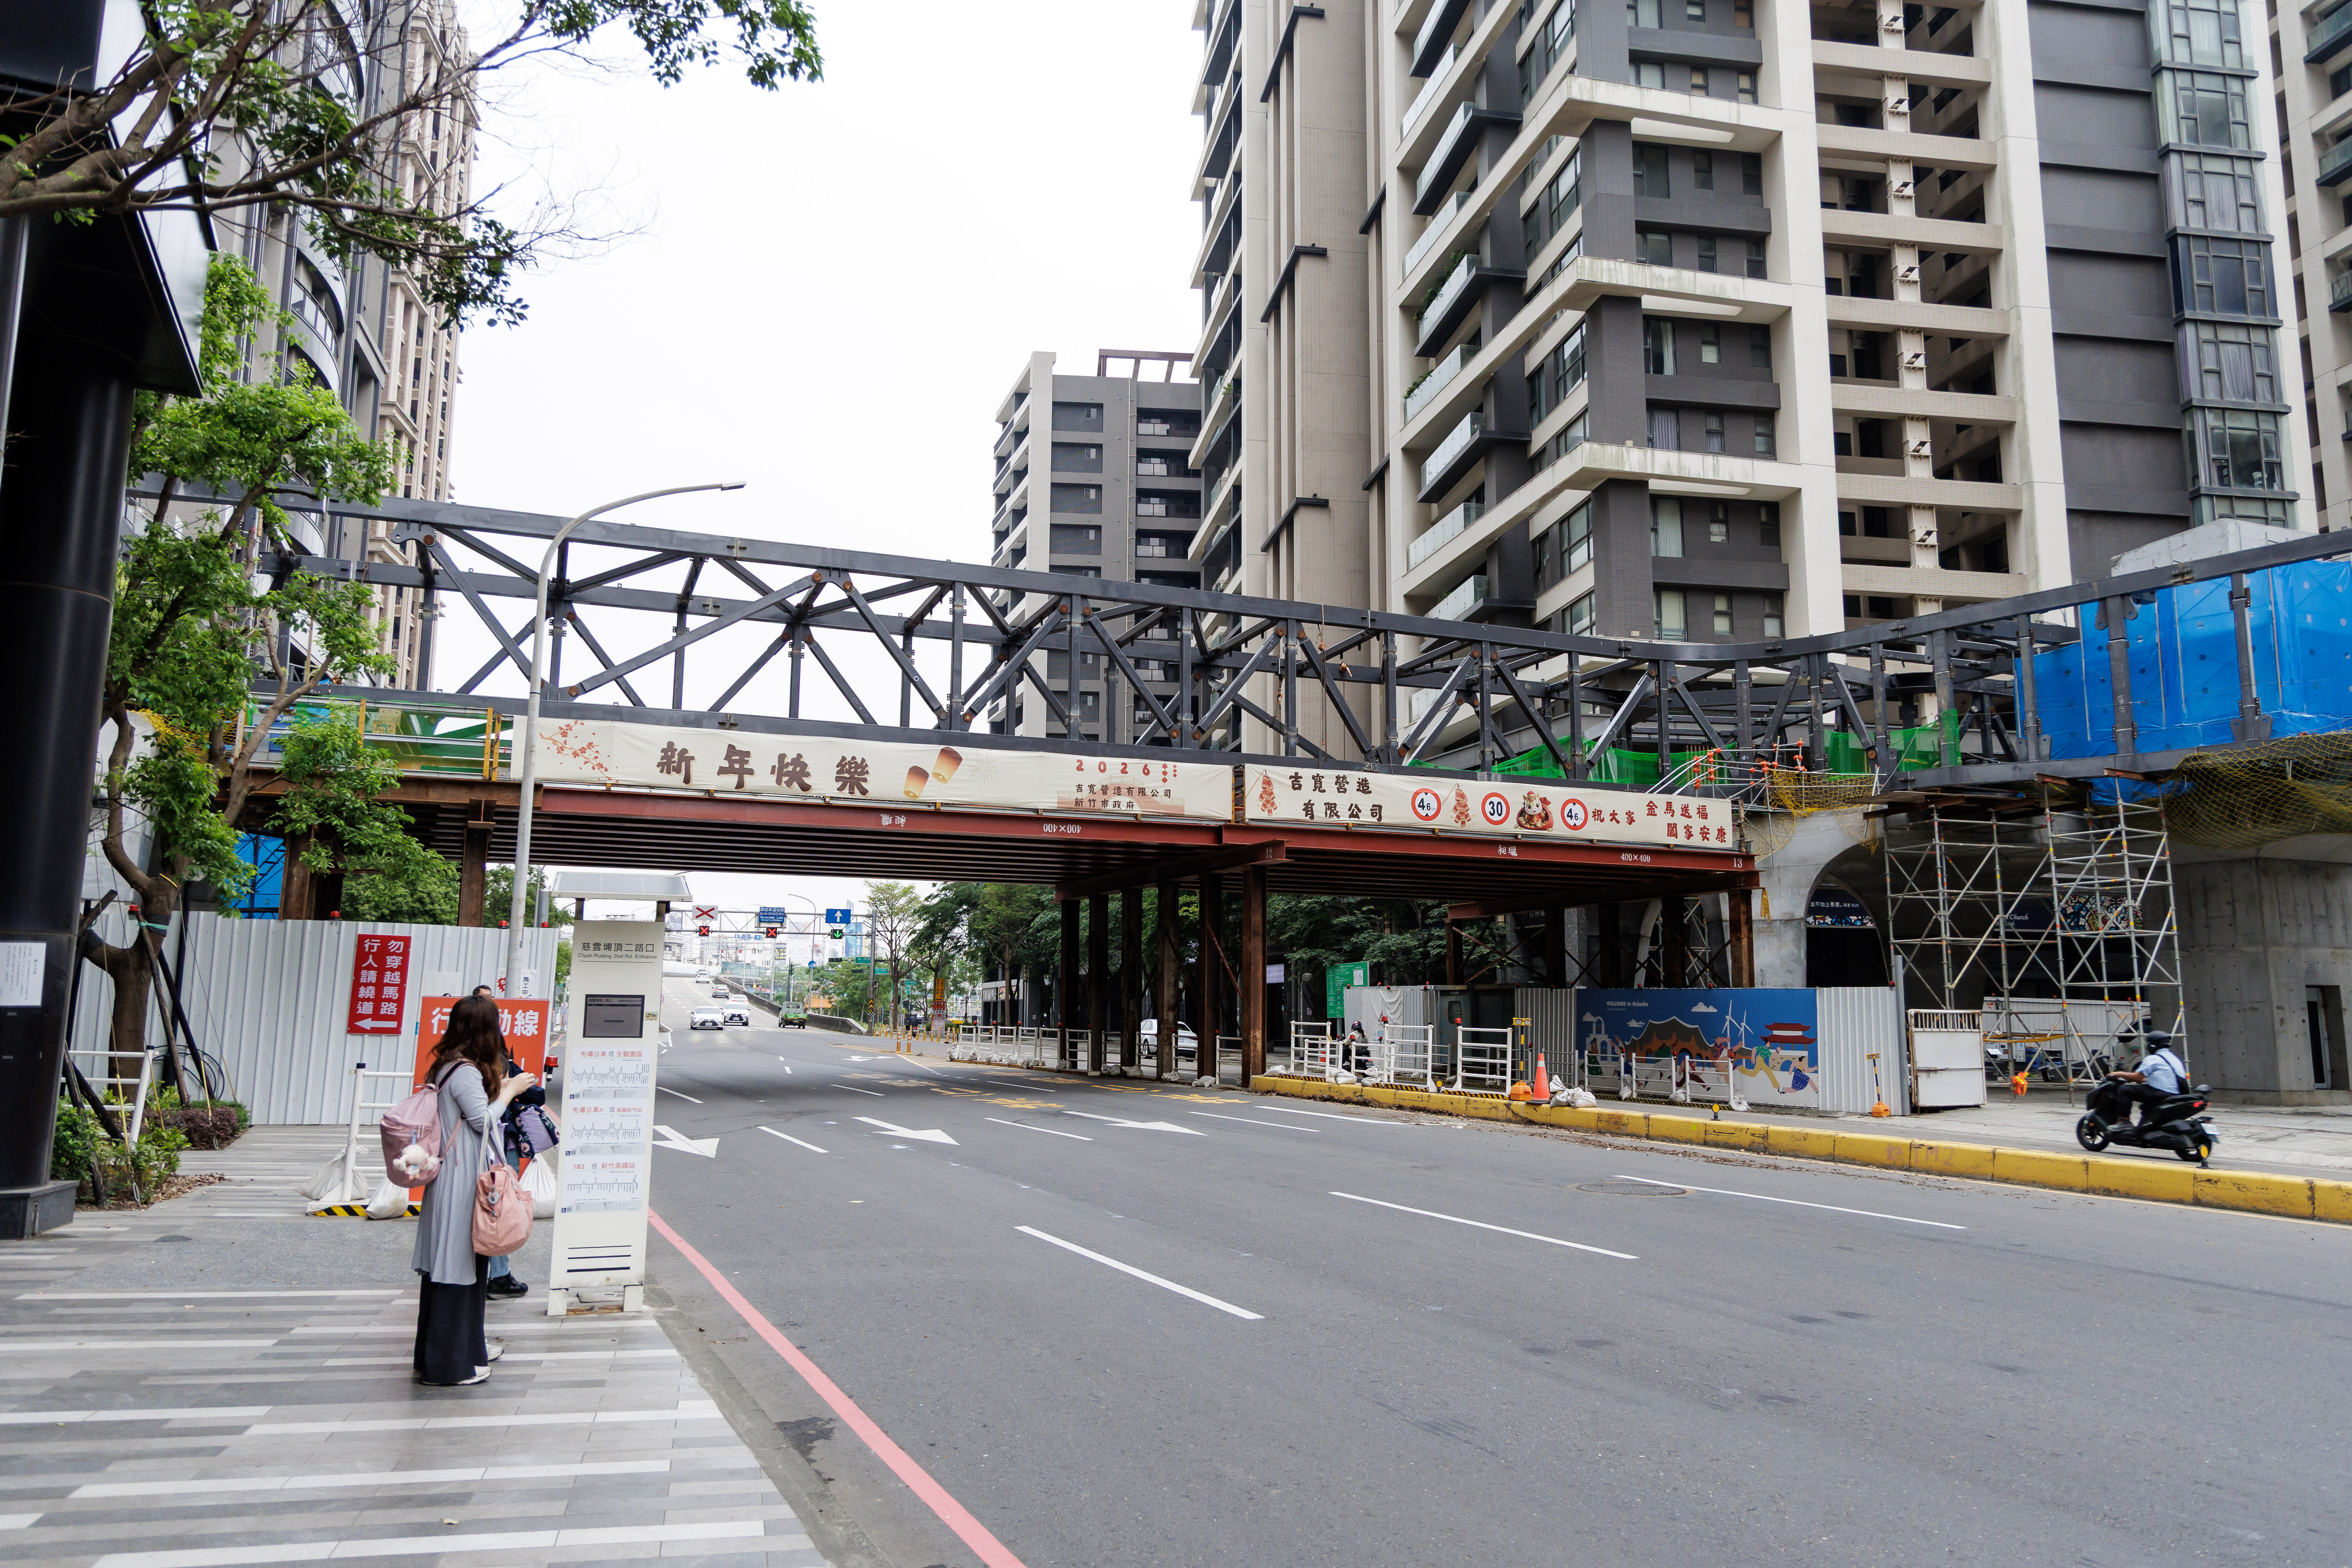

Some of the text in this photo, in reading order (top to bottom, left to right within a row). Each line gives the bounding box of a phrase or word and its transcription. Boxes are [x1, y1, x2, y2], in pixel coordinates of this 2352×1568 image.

[656, 741, 869, 797] 新年快樂
[1077, 759, 1150, 776] 2026
[1075, 783, 1171, 798] 吉寬營造有限公司
[1289, 772, 1372, 794] 吉寬營造
[1074, 797, 1135, 810] 新竹市政府
[1302, 799, 1383, 822] 有限公司
[1418, 798, 1430, 811] 4.6
[1489, 800, 1503, 816] 30
[1646, 800, 1708, 820] 金馬送福
[1567, 808, 1578, 821] 4.6
[1592, 808, 1636, 825] 祝大家
[1667, 823, 1726, 843] 闔家安康
[1266, 846, 1272, 858] 12
[1733, 858, 1742, 868] 13
[581, 942, 654, 952] 慈雲埔頂二路口
[357, 939, 381, 1014] 行人請繞道
[380, 940, 404, 1015] 勿穿越馬路
